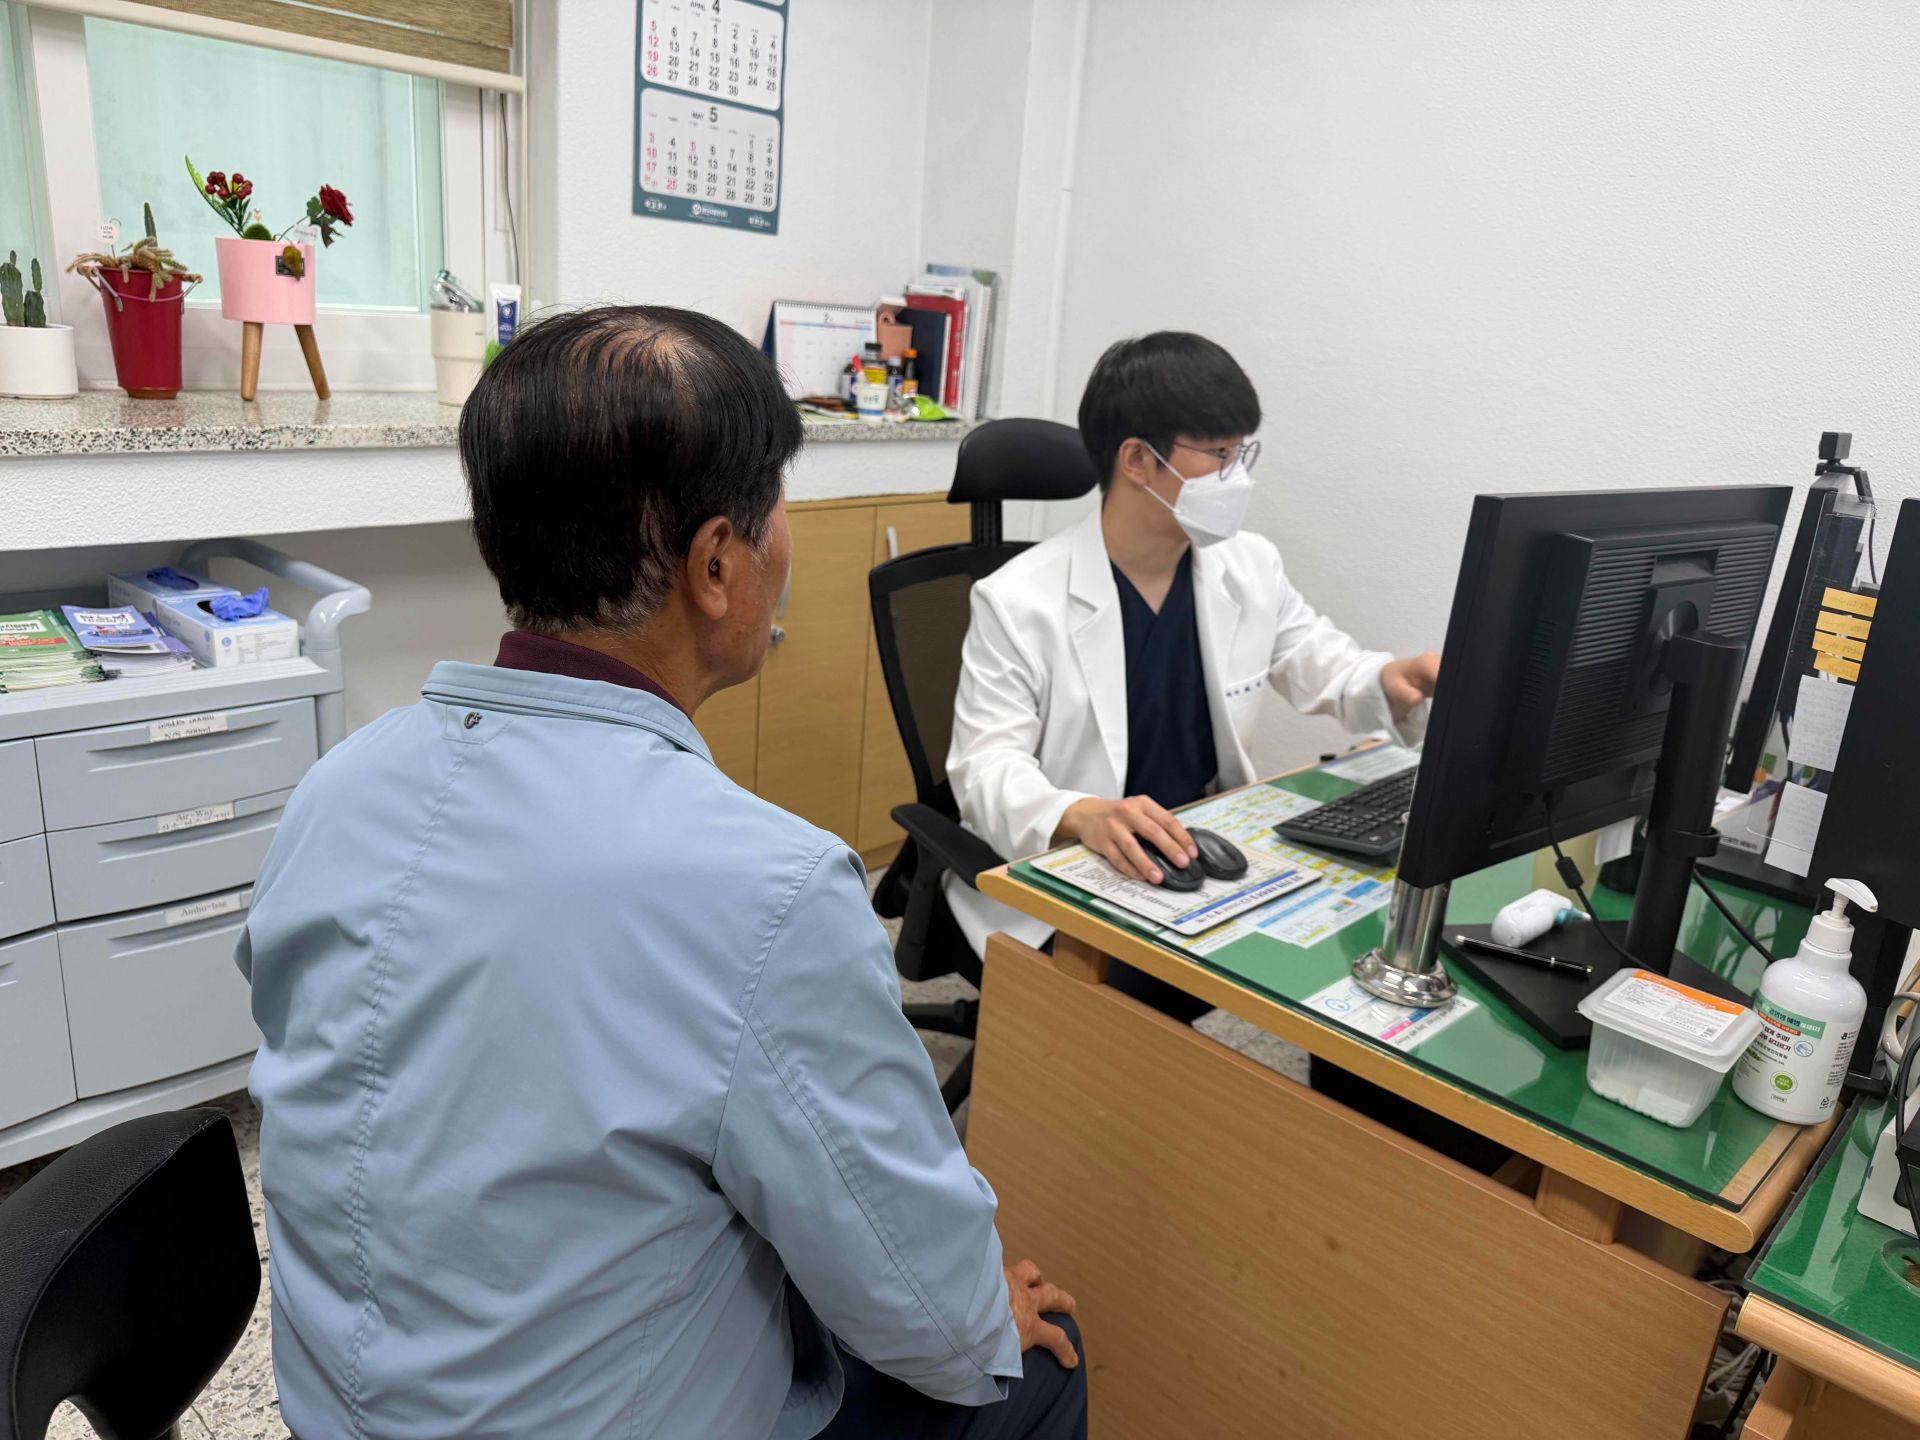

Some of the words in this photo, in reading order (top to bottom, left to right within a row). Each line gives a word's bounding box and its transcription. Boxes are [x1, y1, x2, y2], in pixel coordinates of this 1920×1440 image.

[713, 0, 720, 14] 4
[650, 20, 656, 31] 5
[672, 27, 677, 36] 6
[692, 33, 697, 42] 7
[713, 38, 718, 47] 8
[733, 44, 737, 53] 9
[750, 49, 759, 58] 10
[769, 54, 776, 63] 11
[714, 25, 717, 33] 1
[733, 30, 738, 39] 2
[752, 35, 757, 44] 3
[770, 40, 775, 49] 4
[648, 51, 658, 61] 19
[669, 56, 679, 66] 20
[689, 61, 698, 71] 21
[709, 67, 719, 77] 22
[729, 72, 738, 82] 23
[748, 76, 757, 86] 24
[766, 81, 776, 91] 25
[649, 36, 658, 47] 12
[670, 42, 679, 52] 13
[690, 48, 699, 57] 14
[710, 53, 719, 62] 15
[730, 59, 739, 67] 16
[749, 63, 758, 72] 17
[768, 68, 776, 77] 18
[647, 65, 657, 76] 26
[669, 70, 678, 81] 27
[689, 75, 698, 86] 28
[709, 81, 719, 91] 29
[728, 86, 738, 96] 30
[692, 112, 704, 120] MAY
[709, 107, 718, 122] 5
[650, 133, 654, 143] 3
[670, 138, 675, 146] 4
[691, 141, 696, 151] 5
[710, 145, 715, 154] 6
[730, 149, 735, 159] 7
[748, 153, 754, 162] 8
[767, 158, 772, 166] 9
[768, 144, 772, 153] 2
[647, 148, 657, 158] 10
[668, 152, 676, 161] 11
[689, 156, 698, 166] 12
[709, 160, 717, 169] 13
[728, 164, 736, 173] 14
[747, 168, 756, 177] 15
[765, 172, 773, 181] 16
[647, 162, 656, 172] 17
[668, 166, 677, 176] 18
[688, 170, 697, 179] 19
[708, 173, 717, 183] 20
[727, 177, 736, 186] 21
[746, 181, 755, 190] 22
[763, 184, 772, 194] 23
[667, 180, 677, 190] 25
[687, 184, 697, 193] 26
[707, 187, 716, 197] 27
[726, 191, 735, 200] 28
[745, 194, 754, 204] 29
[763, 197, 772, 206] 30
